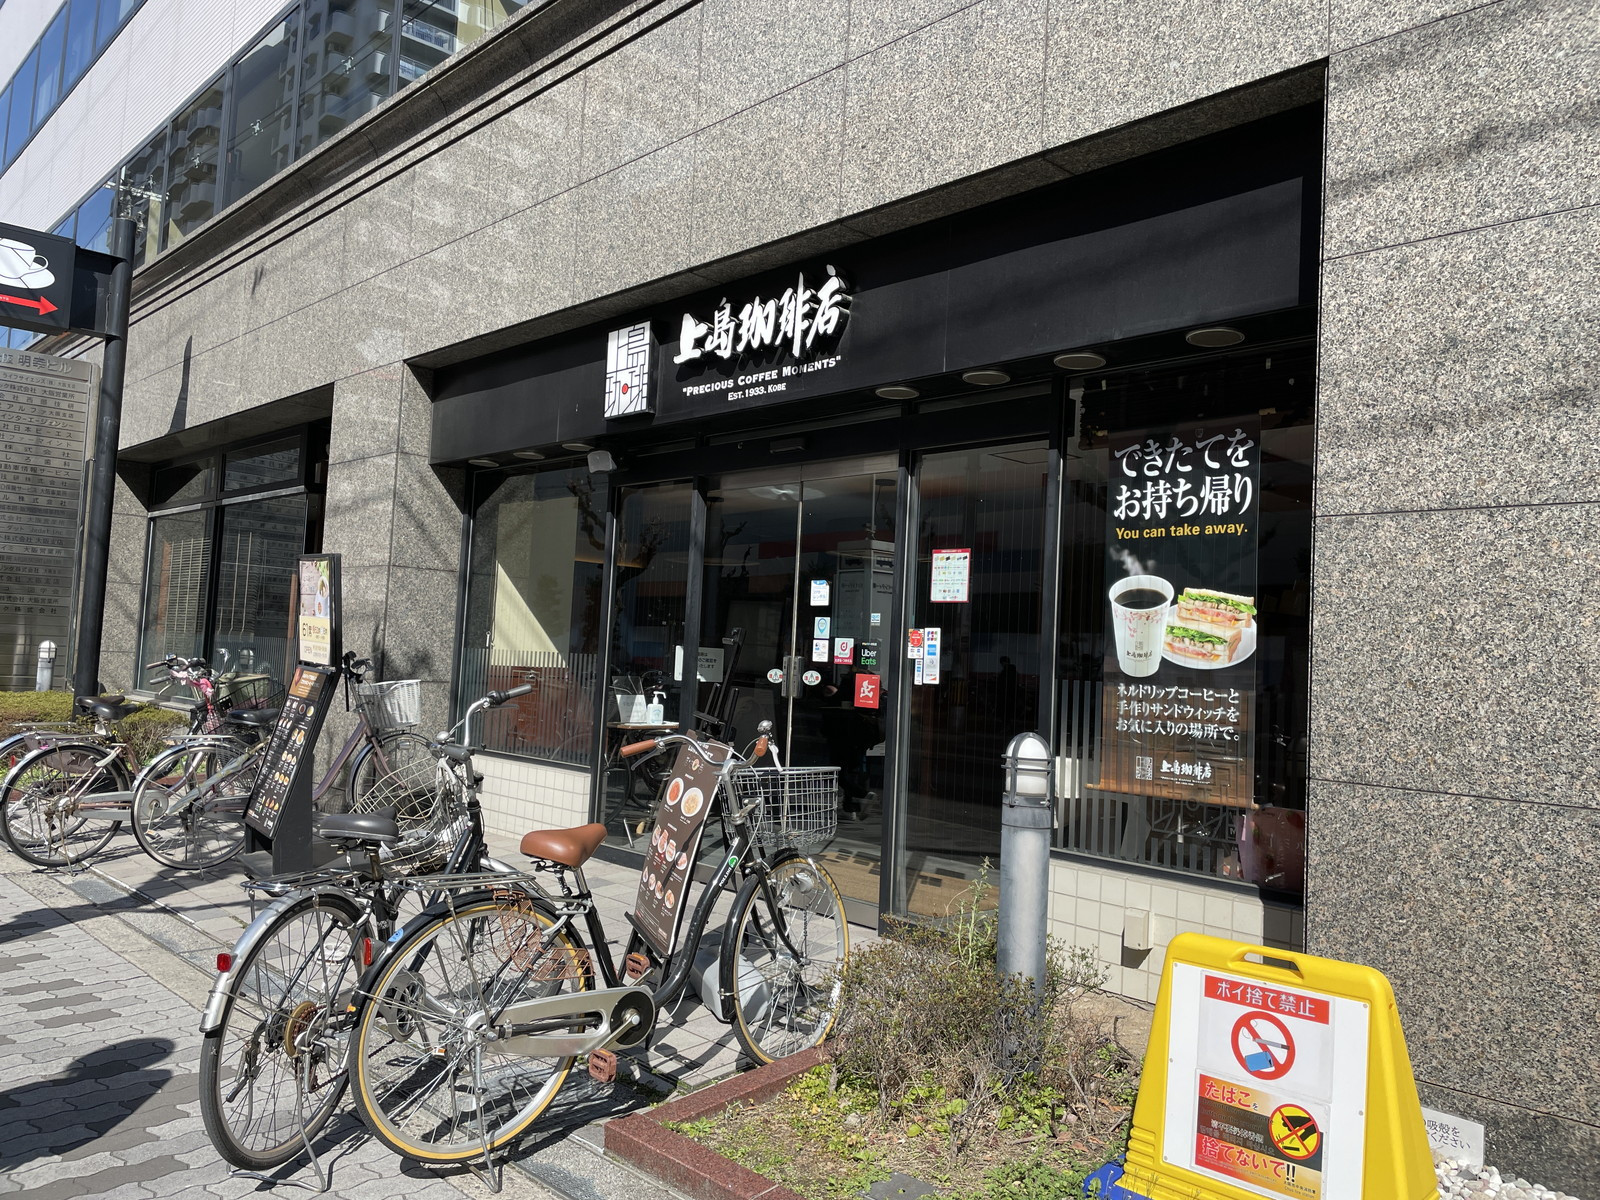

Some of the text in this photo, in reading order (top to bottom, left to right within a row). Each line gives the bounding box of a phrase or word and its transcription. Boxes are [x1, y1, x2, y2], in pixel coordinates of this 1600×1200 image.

[673, 264, 850, 364] 上島珈琲店
[737, 369, 778, 386] COFFEE
[767, 383, 787, 393] KOBE
[1114, 428, 1254, 478] できたてを
[1113, 472, 1253, 521] お持ち帰り
[1115, 523, 1248, 540] You can take away.
[861, 649, 877, 657] Uber
[861, 657, 877, 665] Eats
[1116, 682, 1240, 704] ネルドリップコーヒーと
[1116, 700, 1240, 723] 手作りサンドウィッチを
[1115, 717, 1240, 742] お気に入りの場所で。
[1216, 980, 1316, 1018] ポイ捨て禁止
